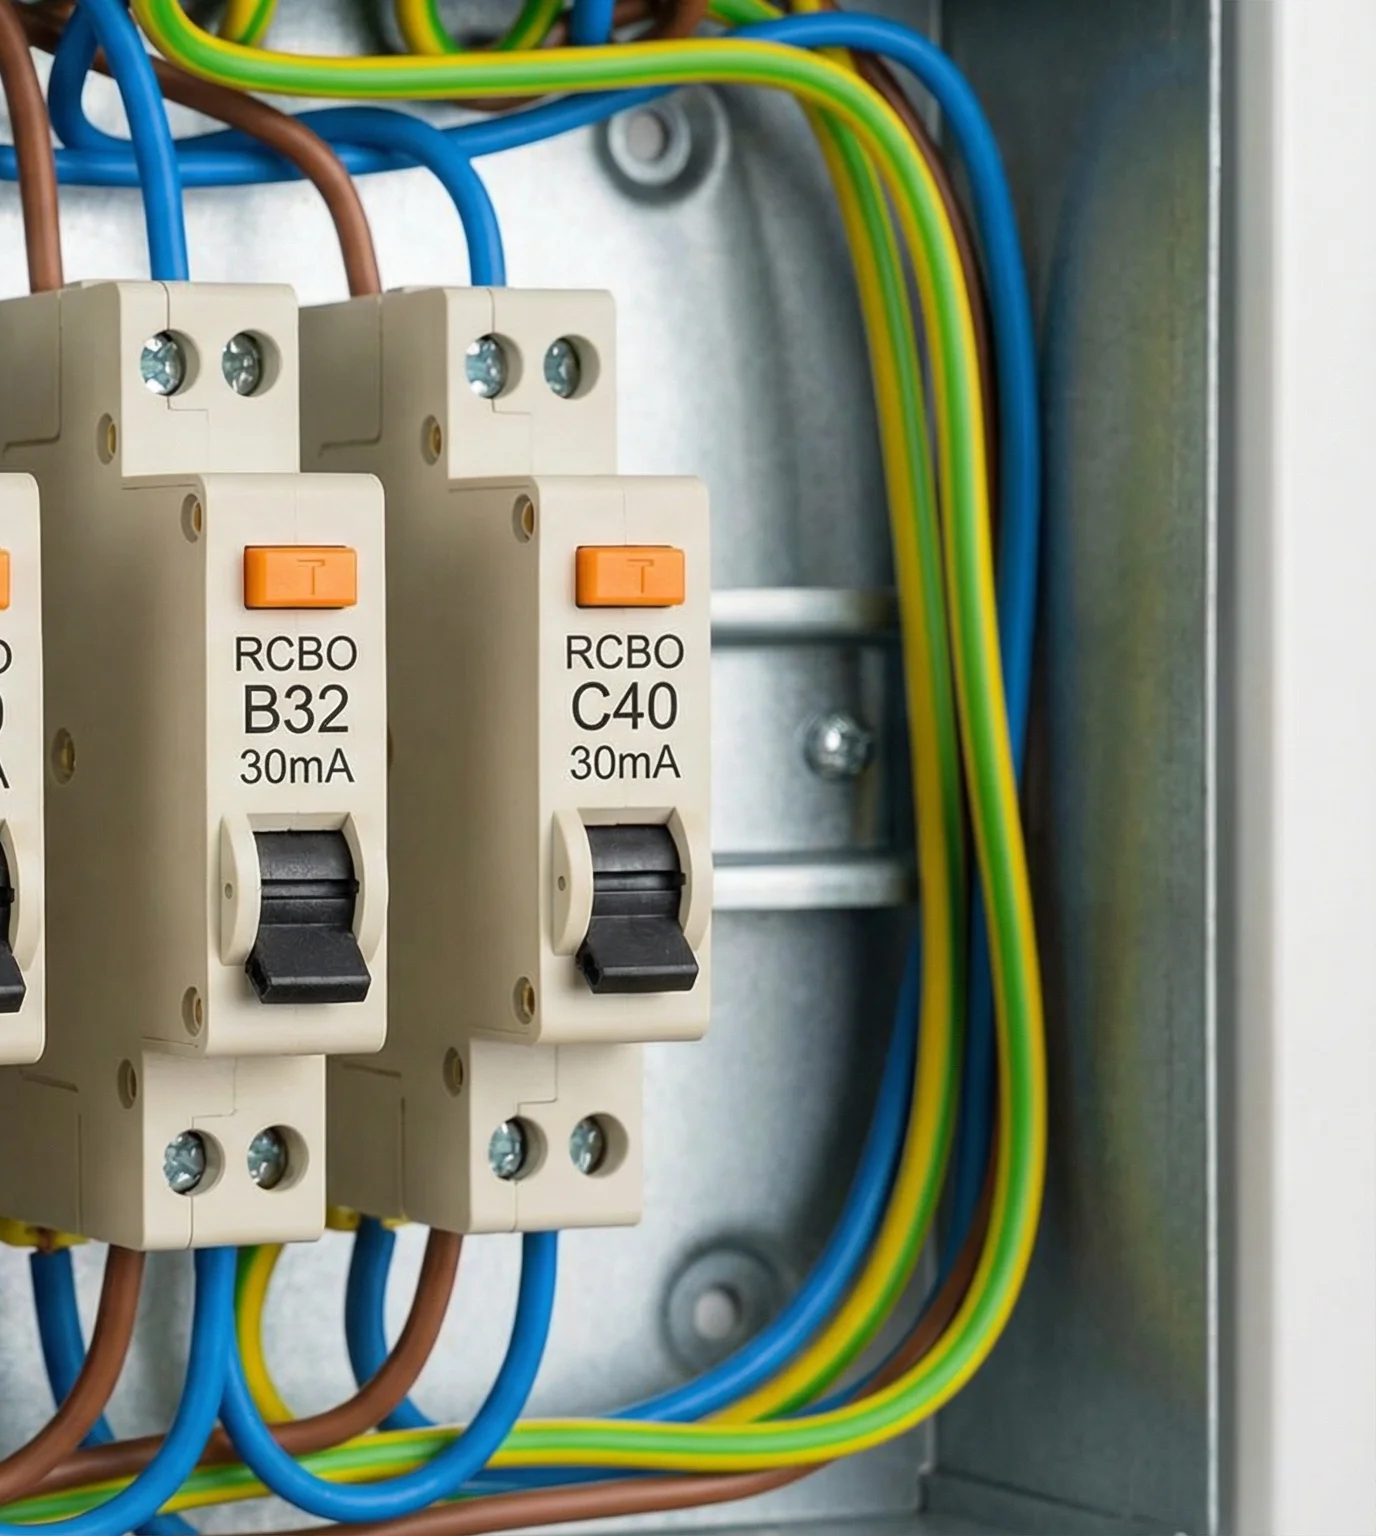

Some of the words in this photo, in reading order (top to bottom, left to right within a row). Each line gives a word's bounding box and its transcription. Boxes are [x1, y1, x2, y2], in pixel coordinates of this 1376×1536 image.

[296, 558, 327, 596] T
[626, 558, 655, 595] T
[235, 635, 358, 672] RCBO
[566, 633, 685, 670] RCBO
[244, 683, 350, 735] B32
[572, 681, 678, 731] C40
[240, 747, 356, 785] 30mA
[570, 744, 682, 780] 30mA
